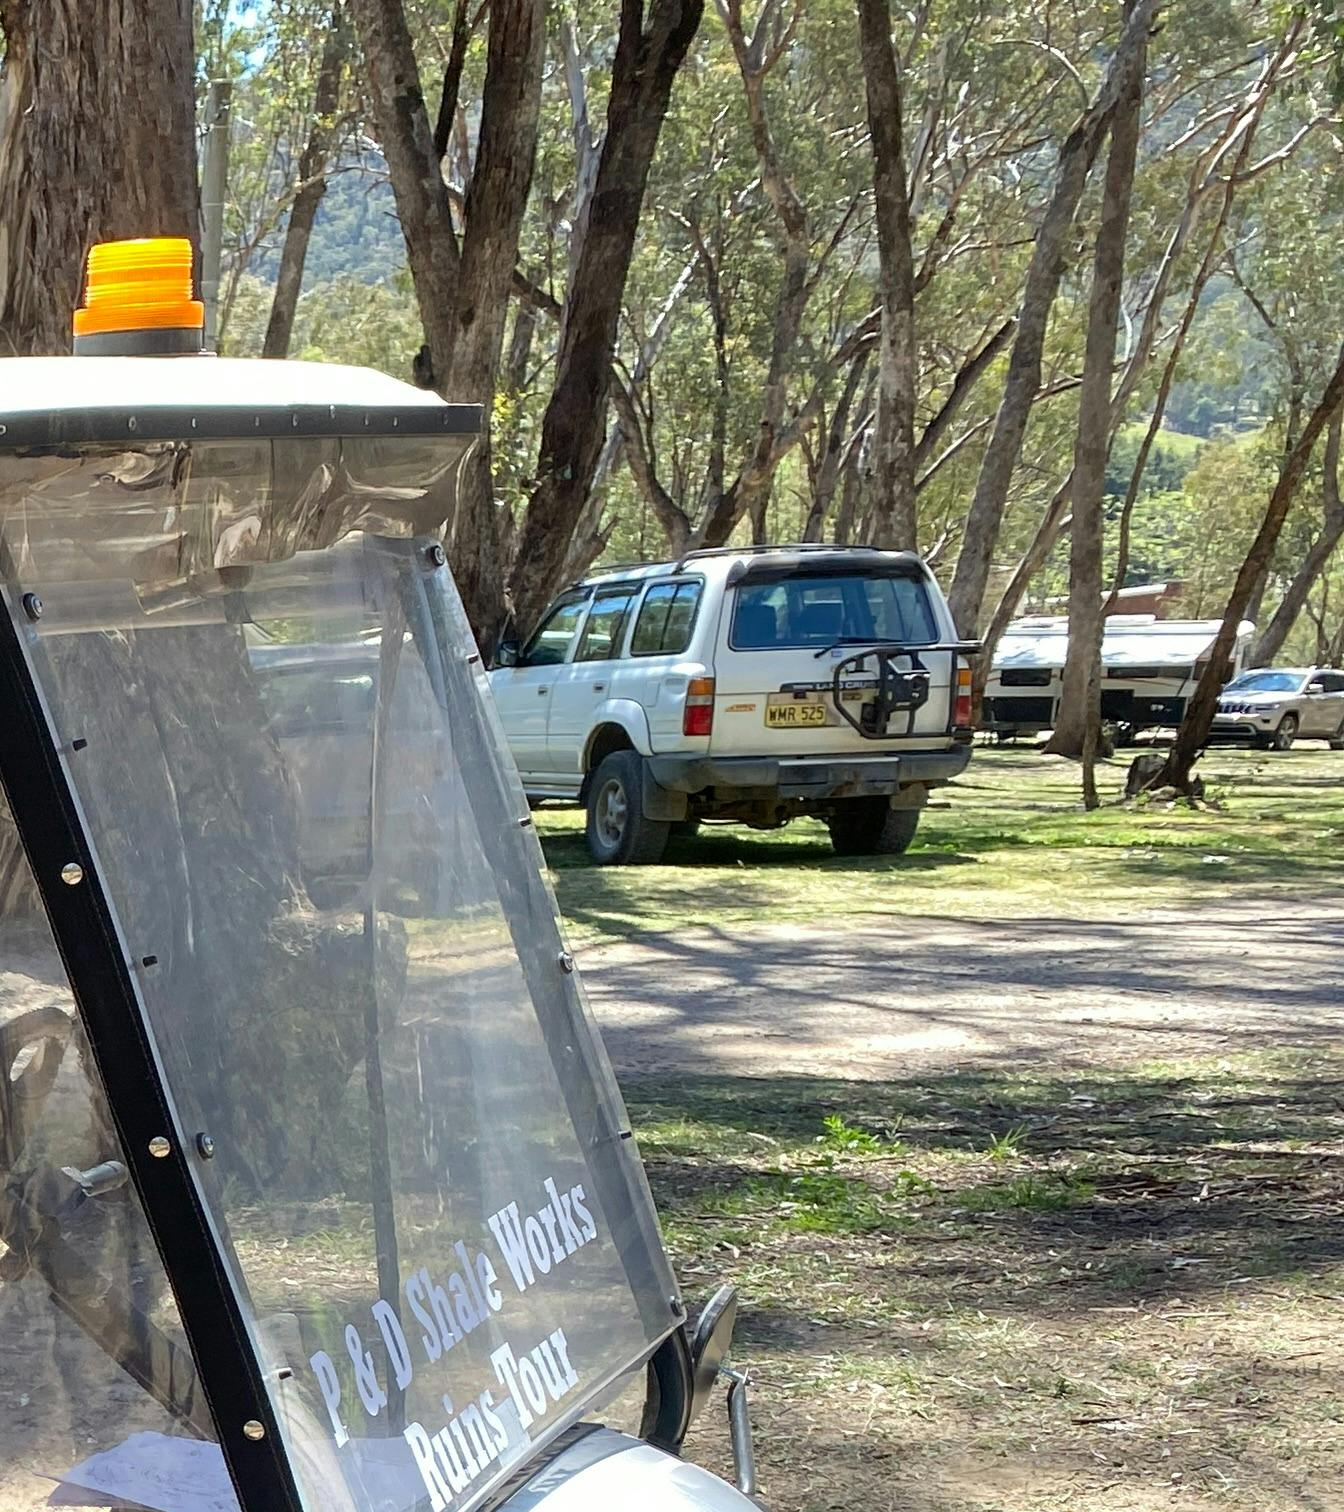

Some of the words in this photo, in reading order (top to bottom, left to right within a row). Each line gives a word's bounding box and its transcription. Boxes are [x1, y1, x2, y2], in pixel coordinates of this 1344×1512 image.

[769, 707, 796, 721] WMR
[801, 706, 825, 721] 525
[309, 1350, 350, 1449] P
[344, 1322, 387, 1417] &
[370, 1299, 411, 1392] D
[405, 1239, 504, 1363] Shale
[487, 1176, 598, 1293] Works
[490, 1327, 579, 1431] Tour
